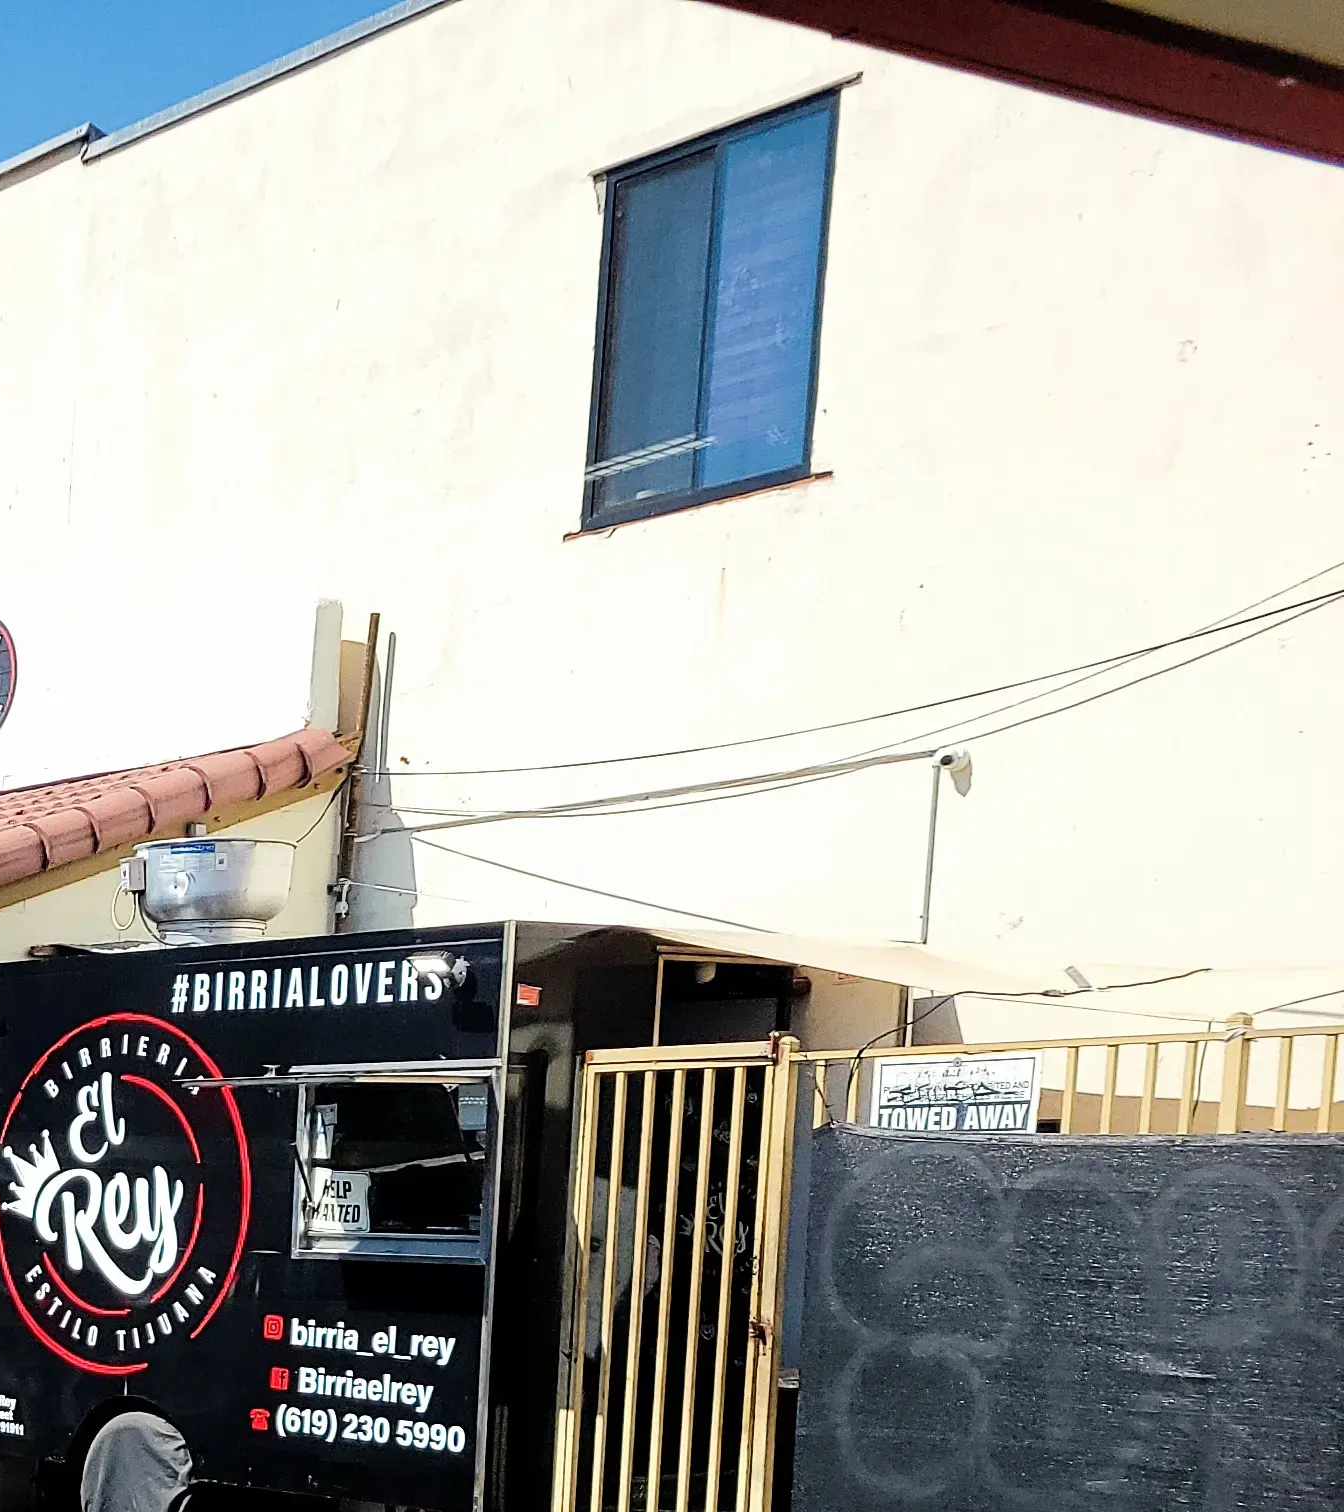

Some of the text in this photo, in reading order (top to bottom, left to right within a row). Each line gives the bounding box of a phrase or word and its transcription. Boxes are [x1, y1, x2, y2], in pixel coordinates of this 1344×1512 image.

[170, 960, 444, 1014] #BIRRIALOVERS
[1012, 1081, 1030, 1090] AND
[69, 1071, 126, 1164] El
[879, 1103, 1030, 1130] TOWED AWAY
[323, 1178, 352, 1200] HELP
[33, 1165, 185, 1296] Rey
[24, 1264, 218, 1352] ESTILO TIJUANA
[289, 1317, 457, 1366] birria_el_rey
[297, 1366, 435, 1414] Birriaelrey
[275, 1403, 467, 1453] (619) 230 5990
